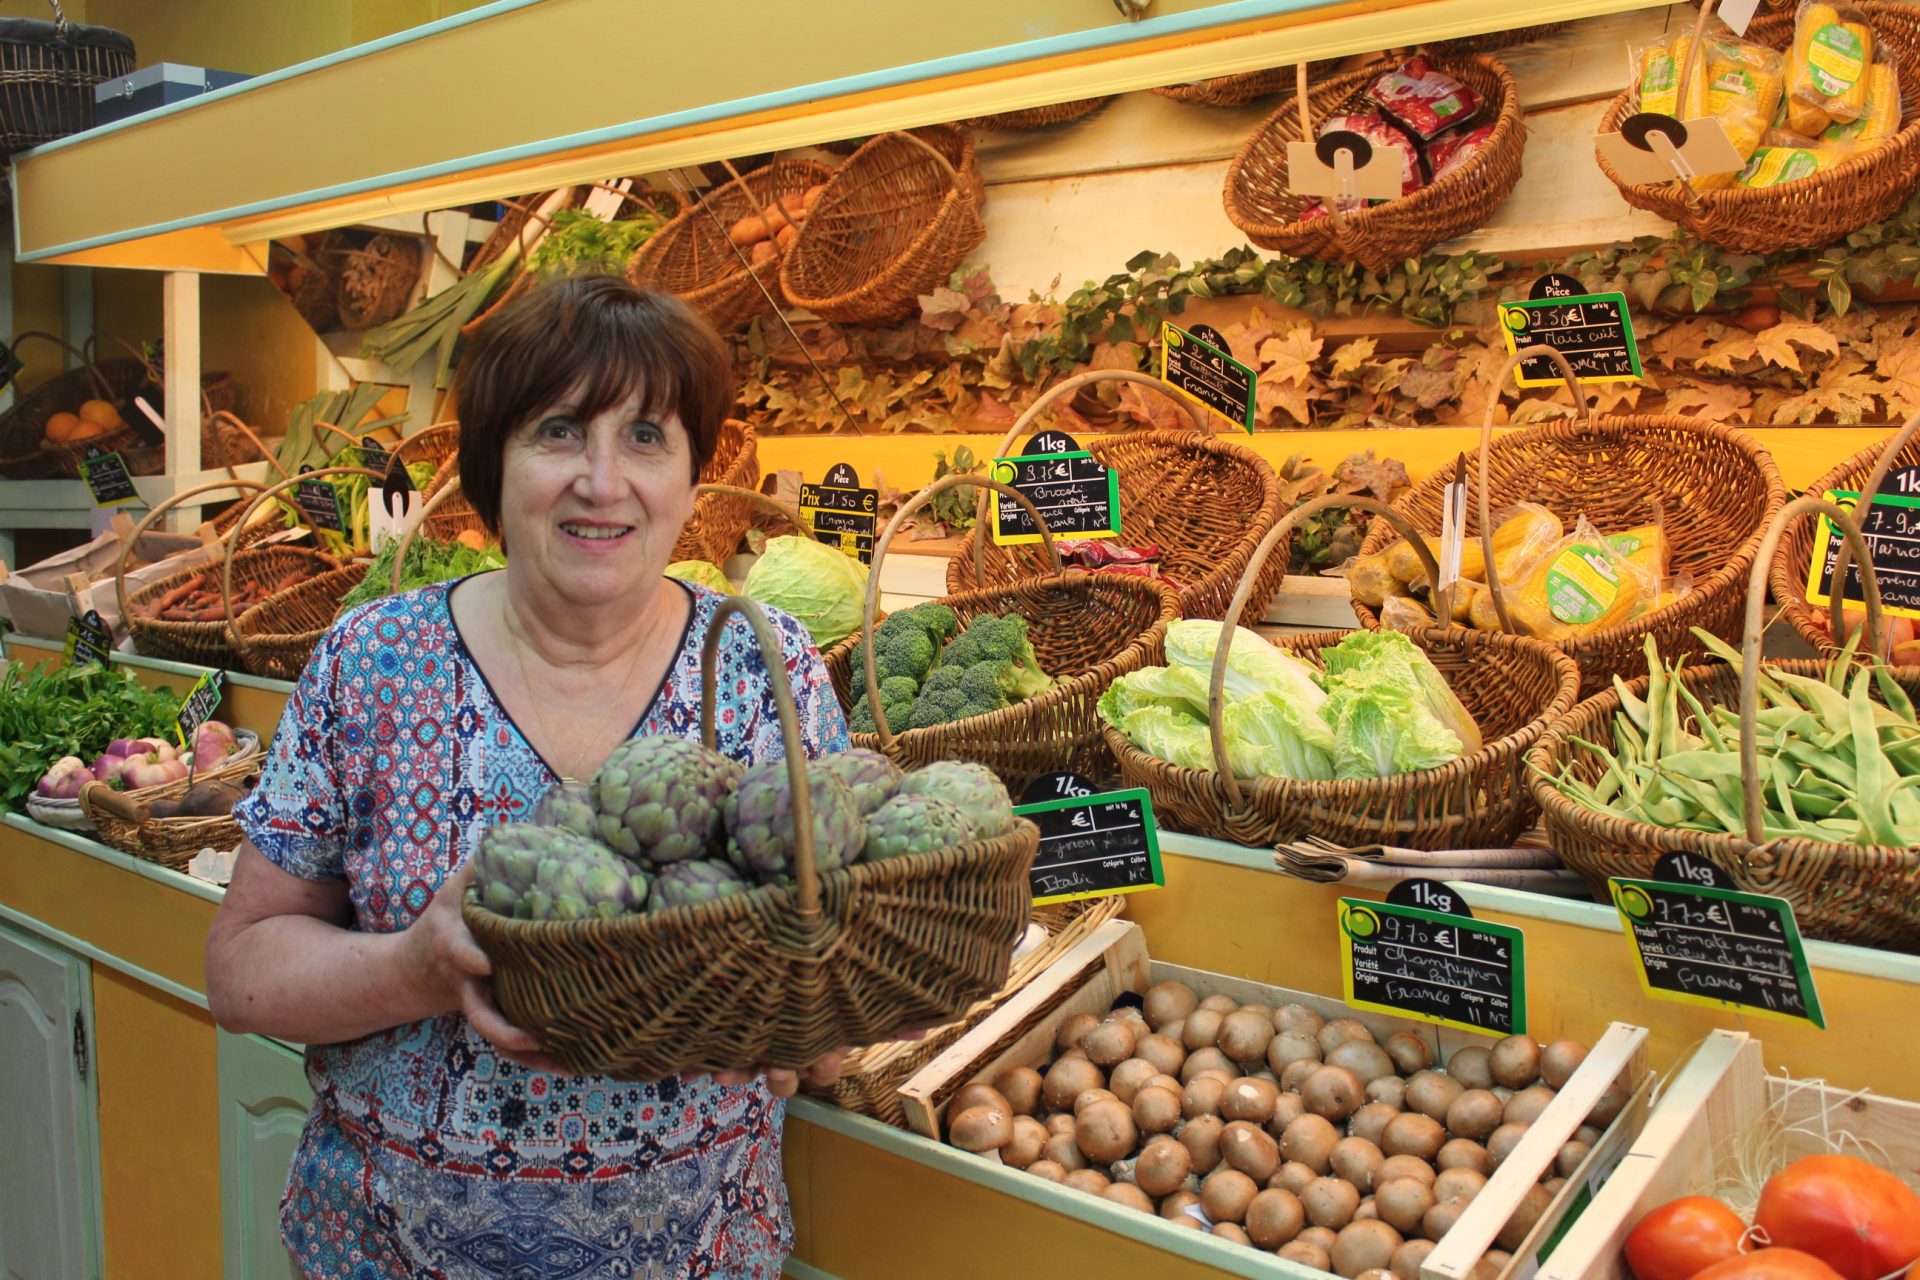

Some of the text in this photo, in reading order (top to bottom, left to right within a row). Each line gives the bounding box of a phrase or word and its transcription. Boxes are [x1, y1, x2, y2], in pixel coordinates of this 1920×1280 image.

[1545, 286, 1570, 297] Pièce
[1548, 358, 1601, 377] Fance
[1038, 434, 1066, 454] 1kg
[833, 473, 849, 484] Pièce
[1055, 463, 1069, 477] €
[801, 486, 820, 507] Prix
[862, 493, 875, 512] €
[1071, 811, 1091, 828] €
[1671, 855, 1715, 887] 1kg
[1410, 882, 1452, 913] 1kg
[1706, 905, 1729, 925] €
[1382, 916, 1455, 948] 9.70 €
[1634, 925, 1658, 938] Produit
[1353, 943, 1378, 956] Produit
[1353, 957, 1380, 970] Variété
[1644, 956, 1668, 970] Origine
[1355, 971, 1380, 984] Origine
[1677, 967, 1744, 992] France
[1385, 980, 1451, 1005] France
[1490, 998, 1509, 1009] Calibre
